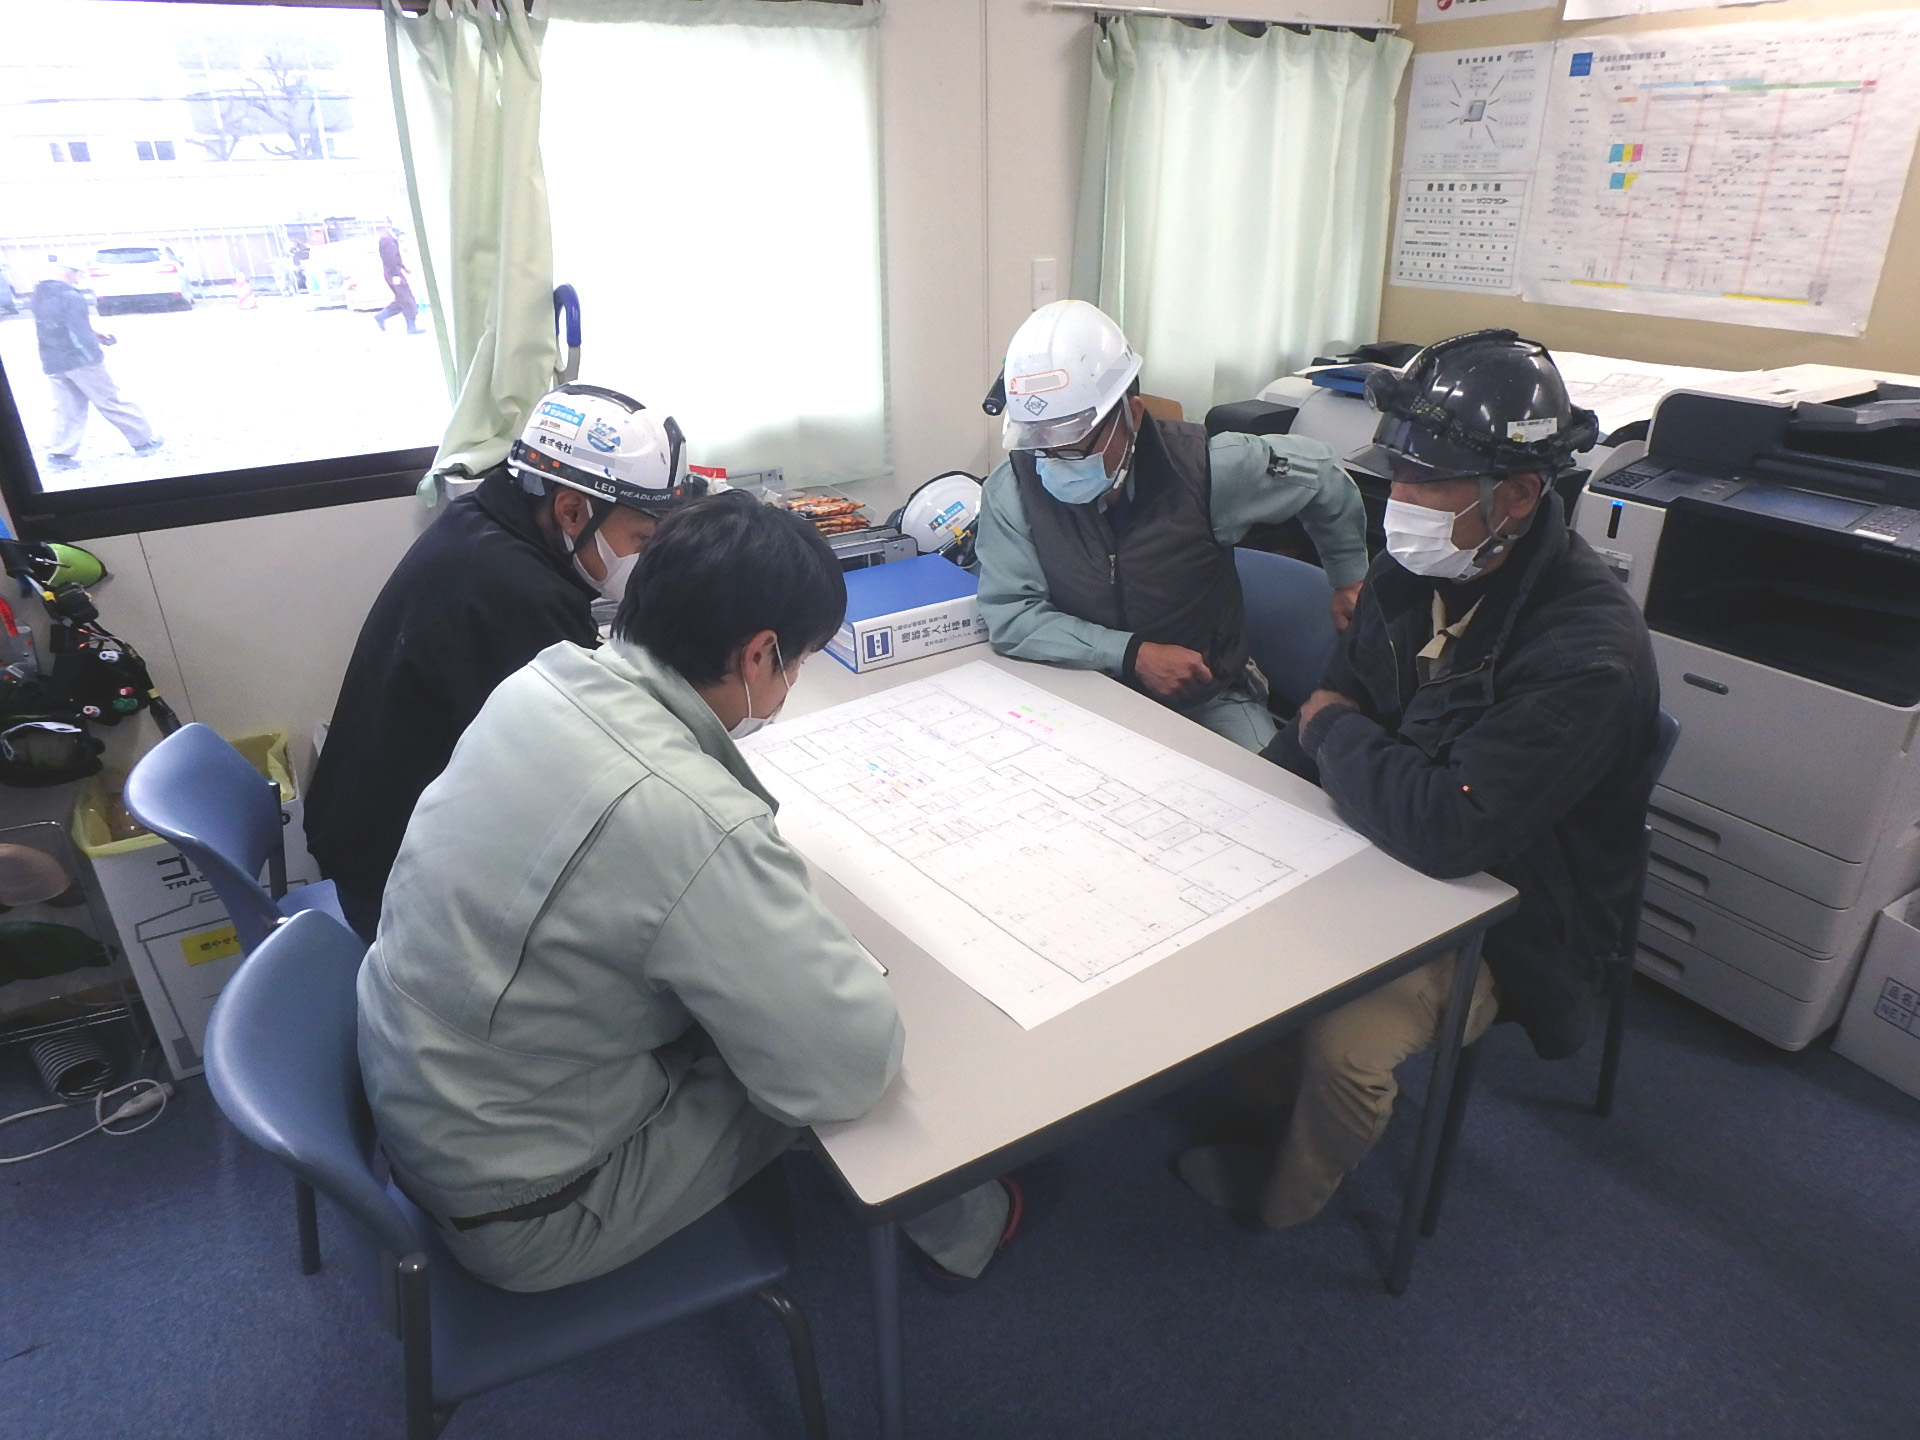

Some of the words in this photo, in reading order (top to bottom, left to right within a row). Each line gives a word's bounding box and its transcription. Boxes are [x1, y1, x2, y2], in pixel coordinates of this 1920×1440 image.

[539, 435, 572, 454] 株式会社
[594, 480, 616, 494] LED
[619, 490, 671, 501] HEADLIGHT
[901, 618, 971, 644] 機器納入仕様書
